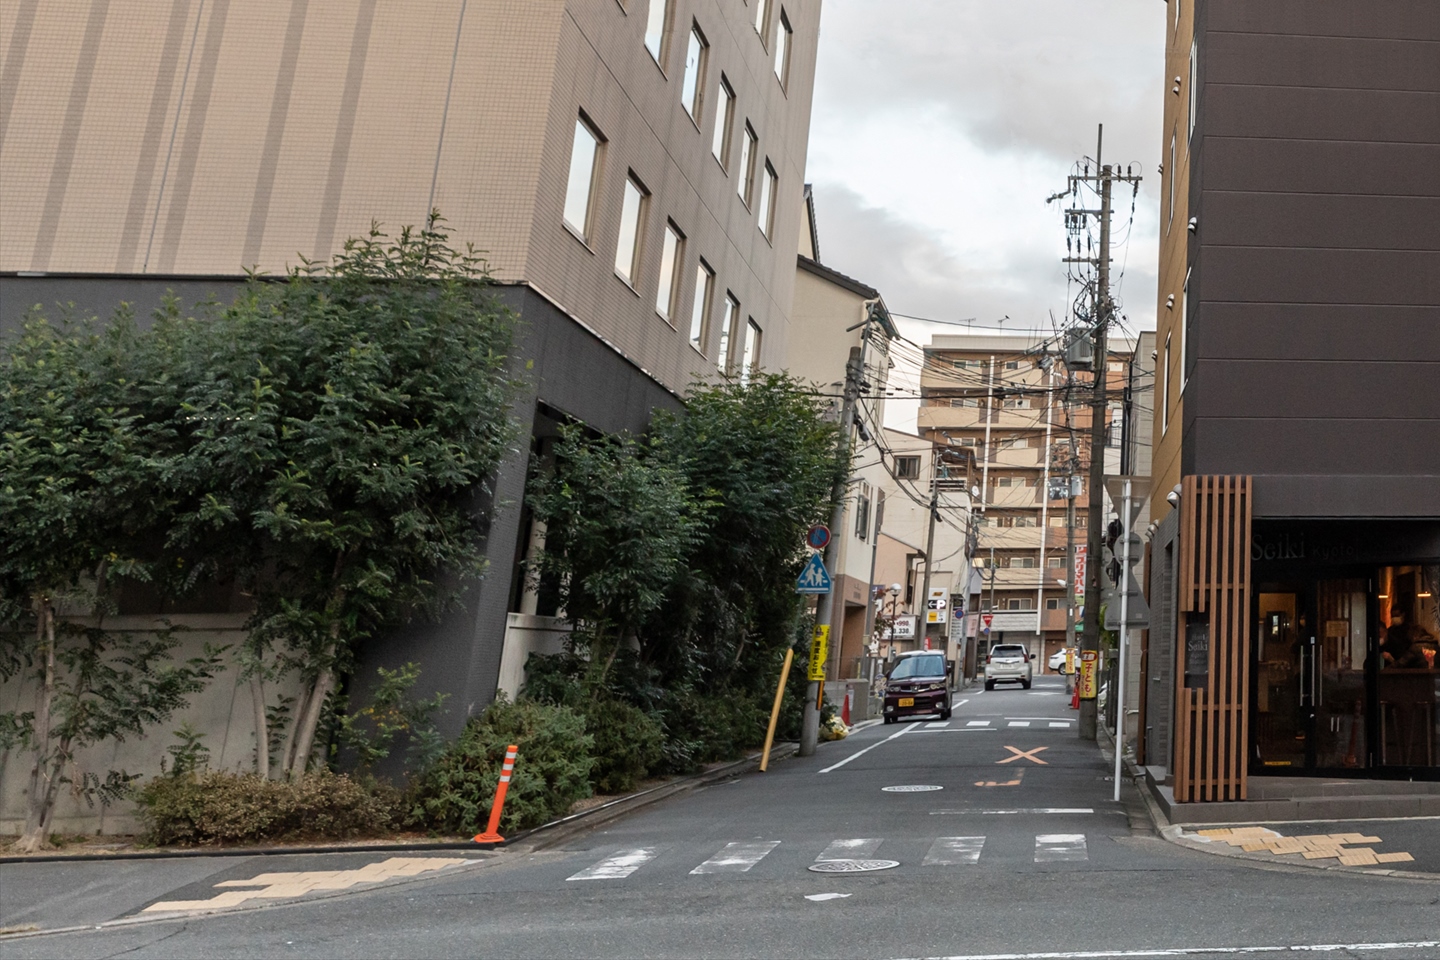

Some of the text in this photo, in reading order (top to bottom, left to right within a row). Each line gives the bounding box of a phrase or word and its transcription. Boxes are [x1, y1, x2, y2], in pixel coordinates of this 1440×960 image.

[1251, 532, 1306, 561] Seiki
[936, 599, 946, 610] P
[1188, 640, 1208, 652] Seiki
